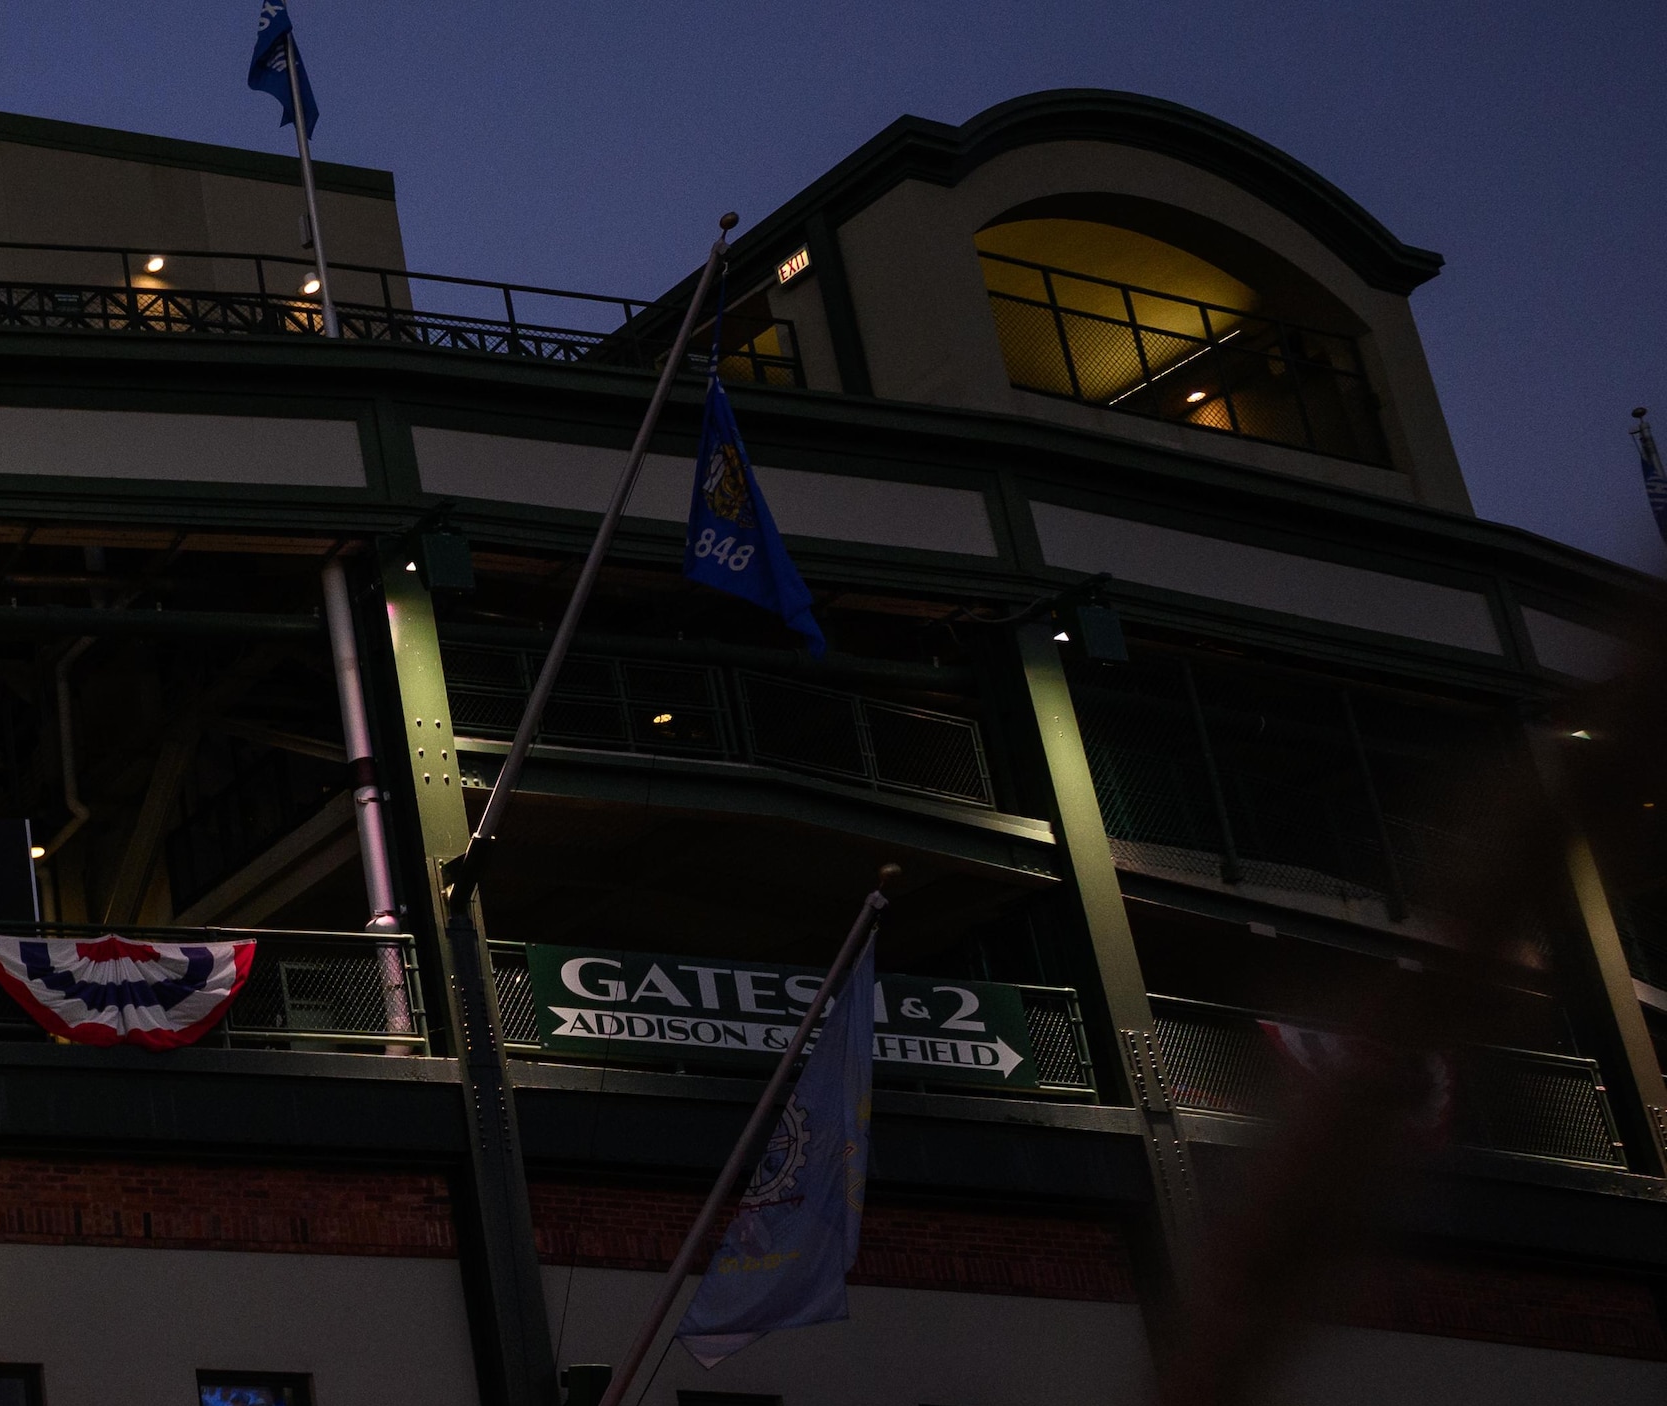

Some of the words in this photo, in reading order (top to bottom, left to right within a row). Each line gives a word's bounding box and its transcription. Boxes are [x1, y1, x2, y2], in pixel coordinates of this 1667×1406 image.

[779, 250, 805, 281] EXIT
[560, 957, 835, 1019] GATES
[899, 997, 931, 1020] &
[932, 986, 987, 1032] 2
[569, 1012, 748, 1046] ADDISON
[761, 1027, 789, 1050] &
